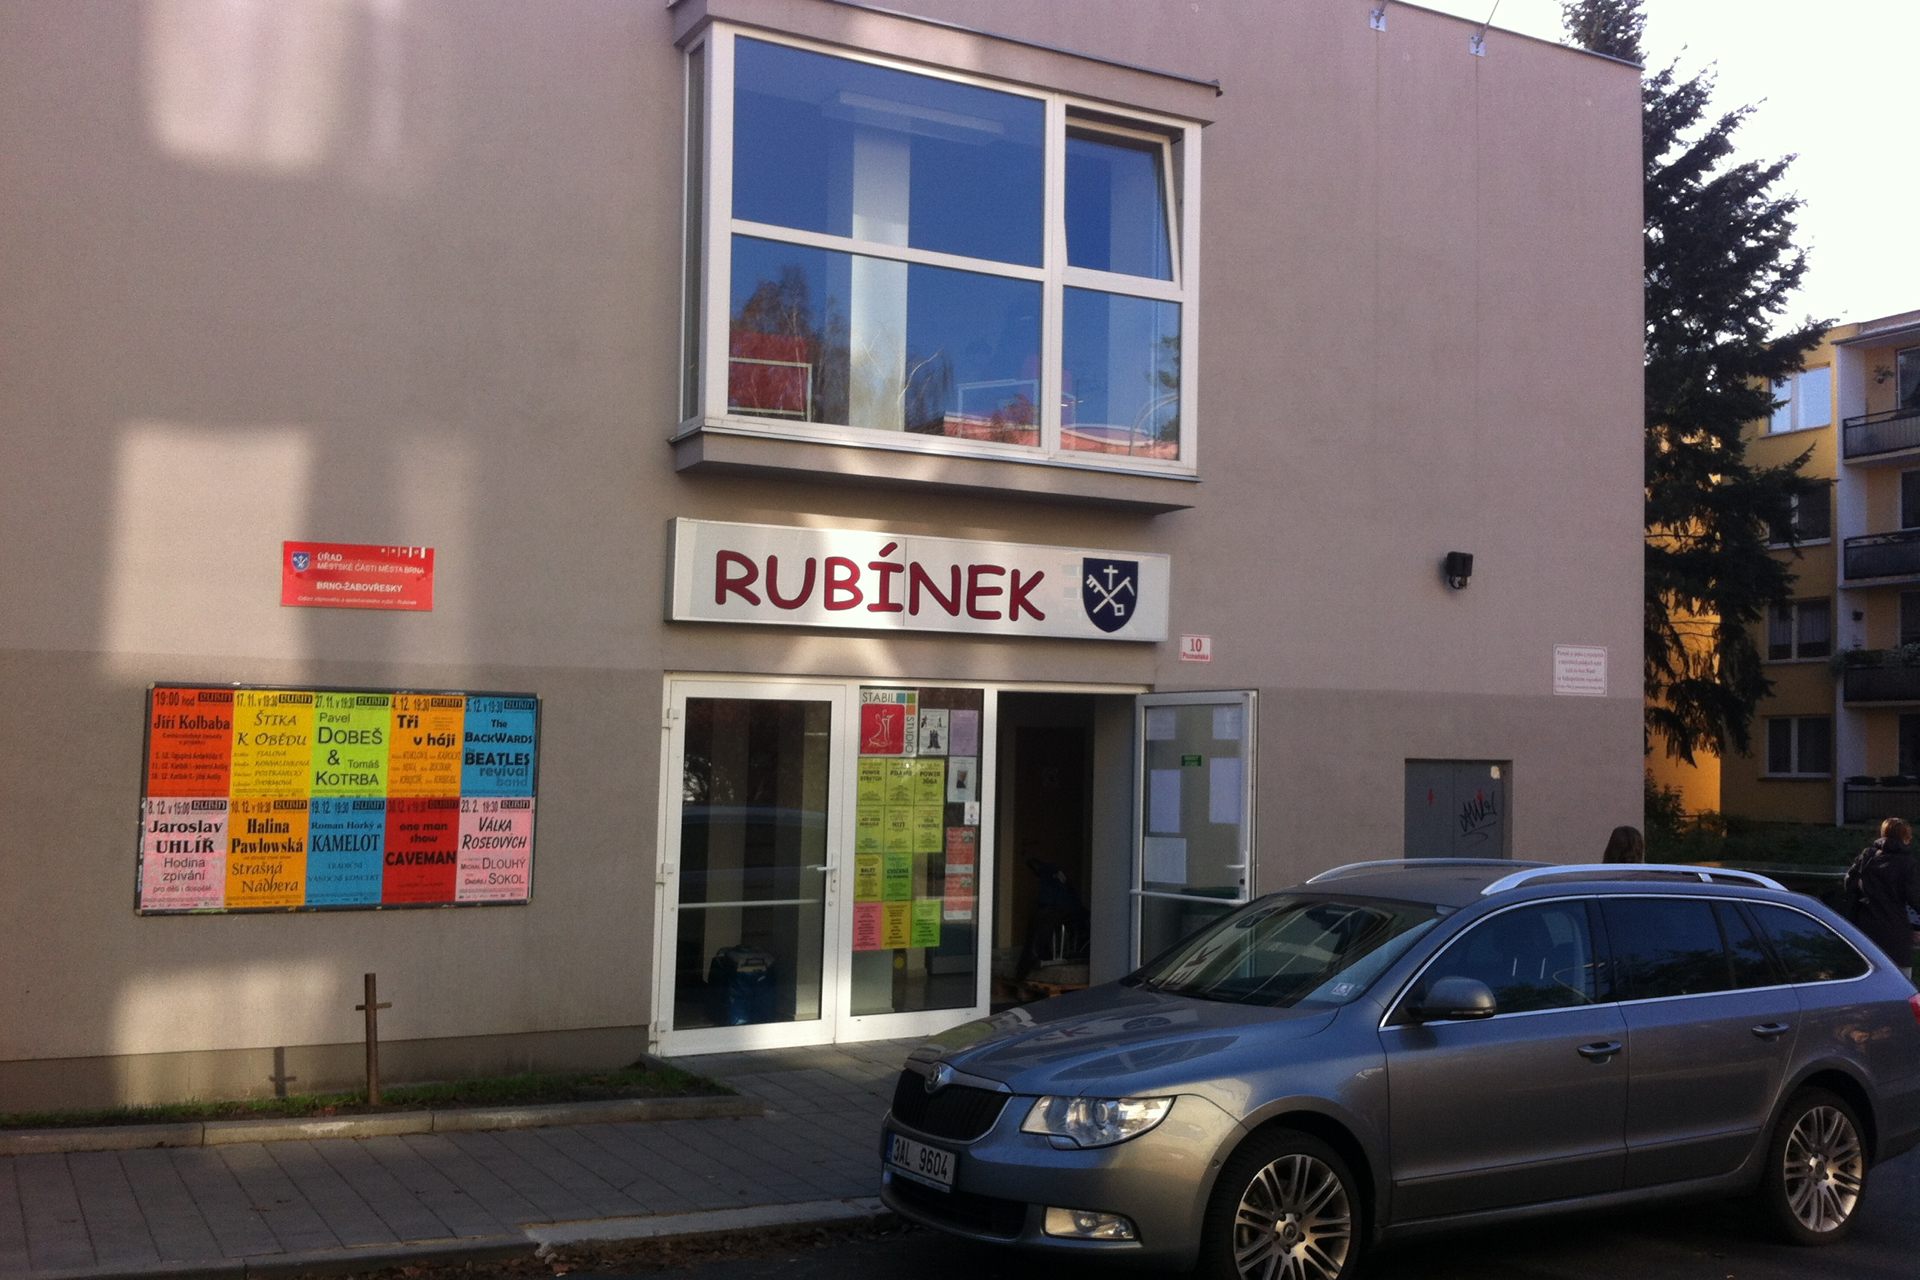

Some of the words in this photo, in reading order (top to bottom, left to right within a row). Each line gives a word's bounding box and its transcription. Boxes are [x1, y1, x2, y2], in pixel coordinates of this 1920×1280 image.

[317, 551, 342, 562] ÚŘAD
[316, 581, 402, 593] BRNO-ŽABOVŘESKY
[715, 541, 1045, 622] RUBÍNEK
[1190, 638, 1202, 652] 10
[862, 692, 895, 703] STABIL
[154, 714, 175, 729] Jiří
[179, 714, 230, 730] Kolbaba
[254, 709, 297, 726] ŠTIKA
[319, 712, 351, 723] Pavel
[397, 714, 419, 729] Tři
[491, 719, 508, 728] The
[237, 732, 249, 746] K
[255, 732, 306, 746] OBĚDU
[413, 736, 422, 746] v
[427, 732, 456, 748] háji
[905, 716, 914, 754] STUDIO
[327, 749, 340, 765] &
[347, 759, 379, 769] Tomáš
[464, 752, 530, 766] BEATLES
[480, 765, 528, 777] revival
[316, 771, 379, 786] KOTRBA
[496, 777, 528, 787] band
[148, 820, 223, 833] Jaroslav
[247, 818, 290, 834] Halina
[347, 822, 374, 831] Horký
[400, 823, 419, 831] one
[423, 823, 448, 831] man
[479, 816, 512, 832] VÁLKA
[156, 835, 214, 854] UHLÍŘ
[231, 837, 303, 854] Pawlowská
[312, 834, 380, 852] KAMELOT
[410, 834, 438, 843] show
[462, 833, 527, 850] ROSEOVÝCH
[164, 858, 205, 868] Hodina
[385, 850, 457, 866] CAVEMAN
[482, 857, 526, 870] DLOUHÝ
[232, 861, 283, 875] Strašná
[163, 870, 205, 883] zpívání
[242, 874, 299, 893] Nádhera
[489, 873, 524, 885] SOKOL
[894, 1138, 910, 1167] 3AL
[919, 1148, 948, 1180] 9604
